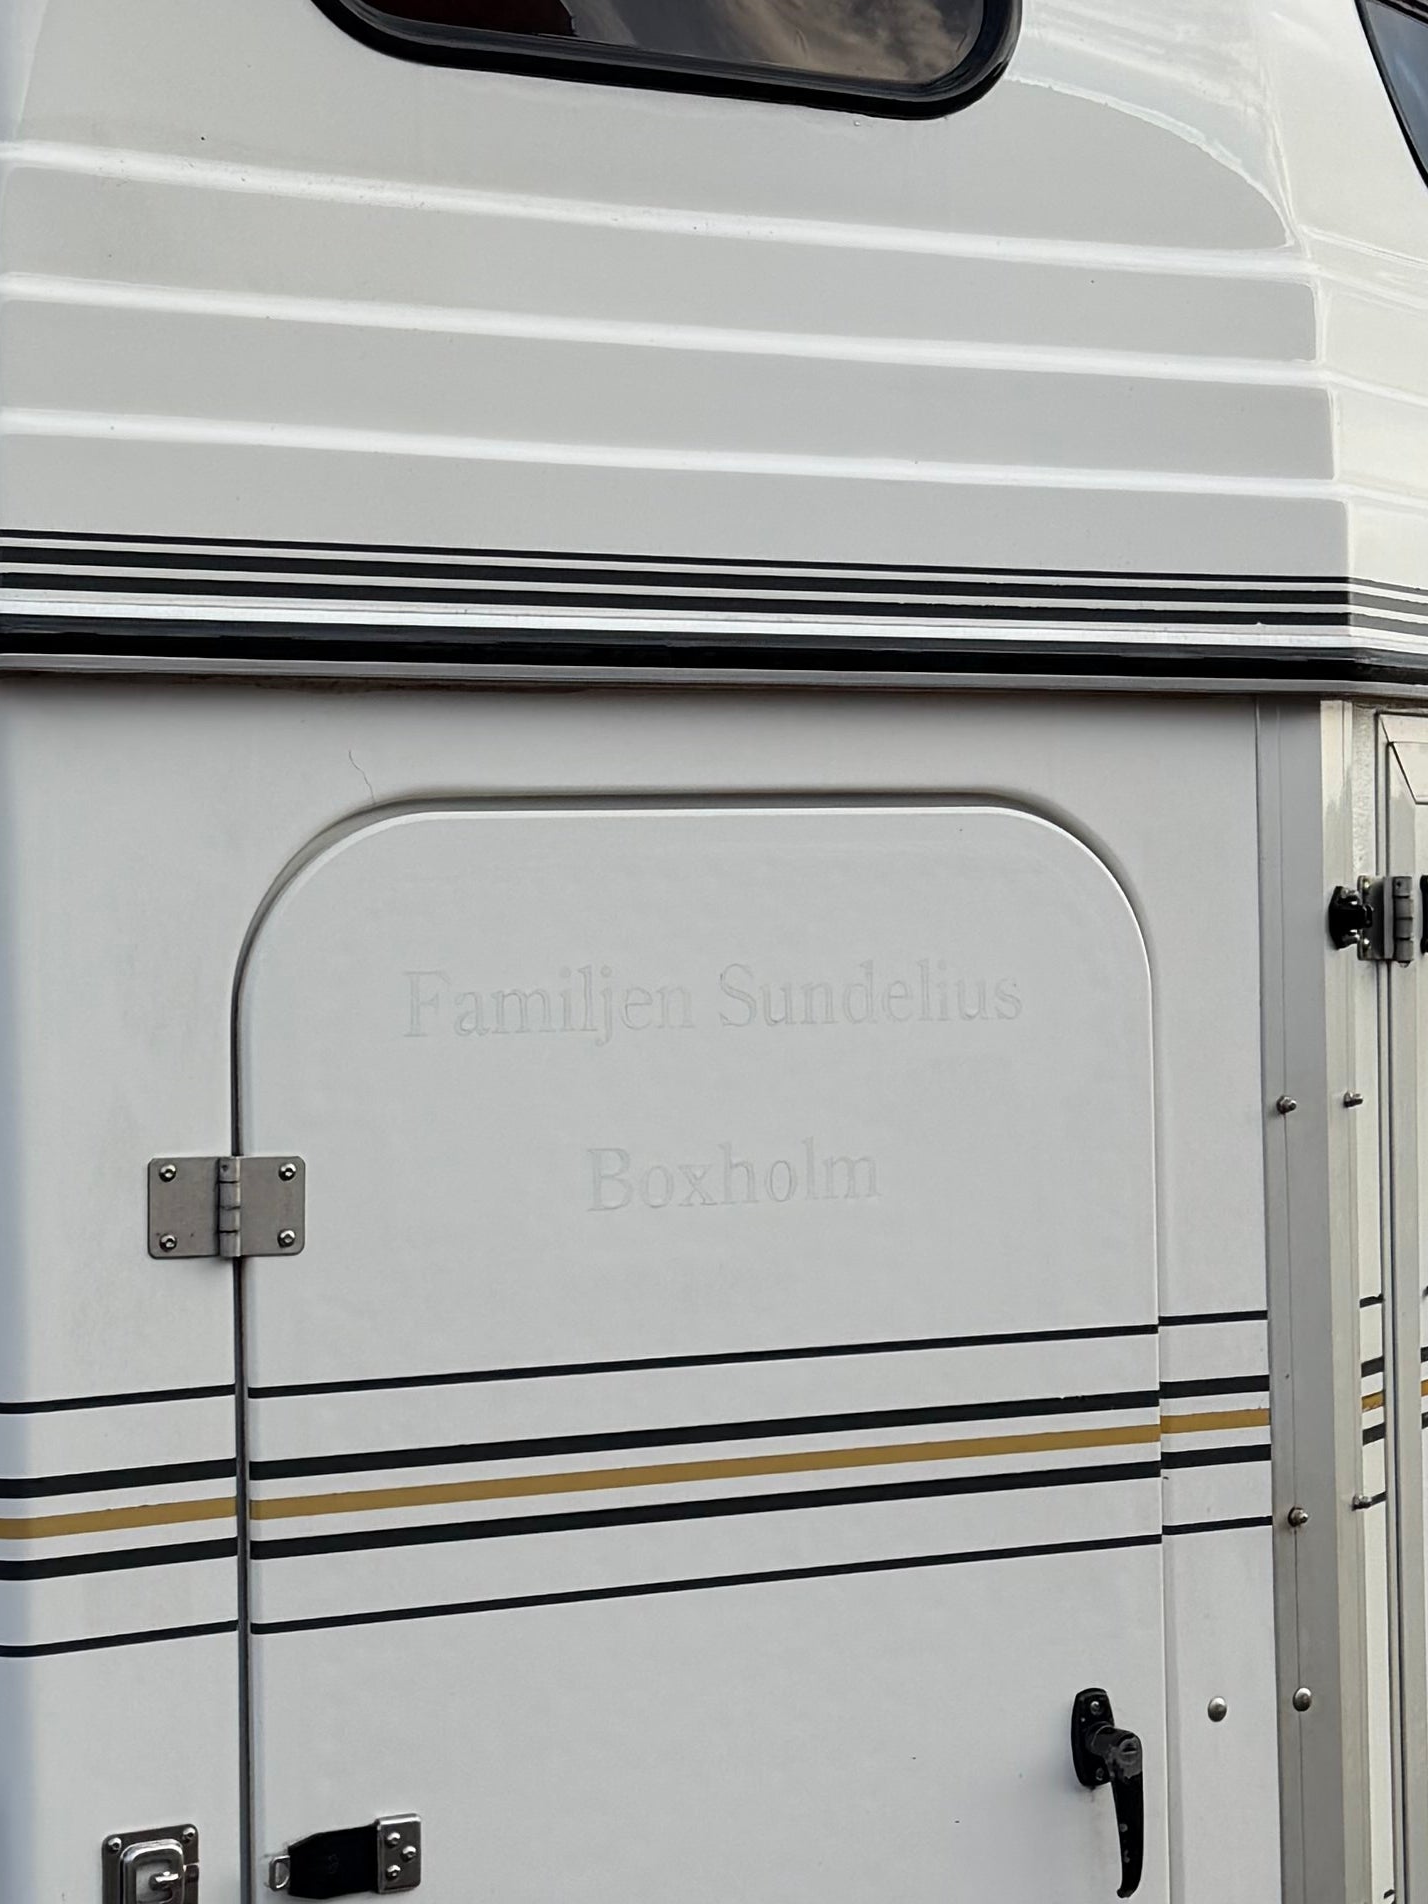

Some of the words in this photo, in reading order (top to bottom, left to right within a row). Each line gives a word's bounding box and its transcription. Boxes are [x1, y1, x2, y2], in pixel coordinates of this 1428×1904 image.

[402, 964, 698, 1046] Familjen
[716, 959, 1025, 1029] Sundelius
[585, 1137, 882, 1213] Boxholm
